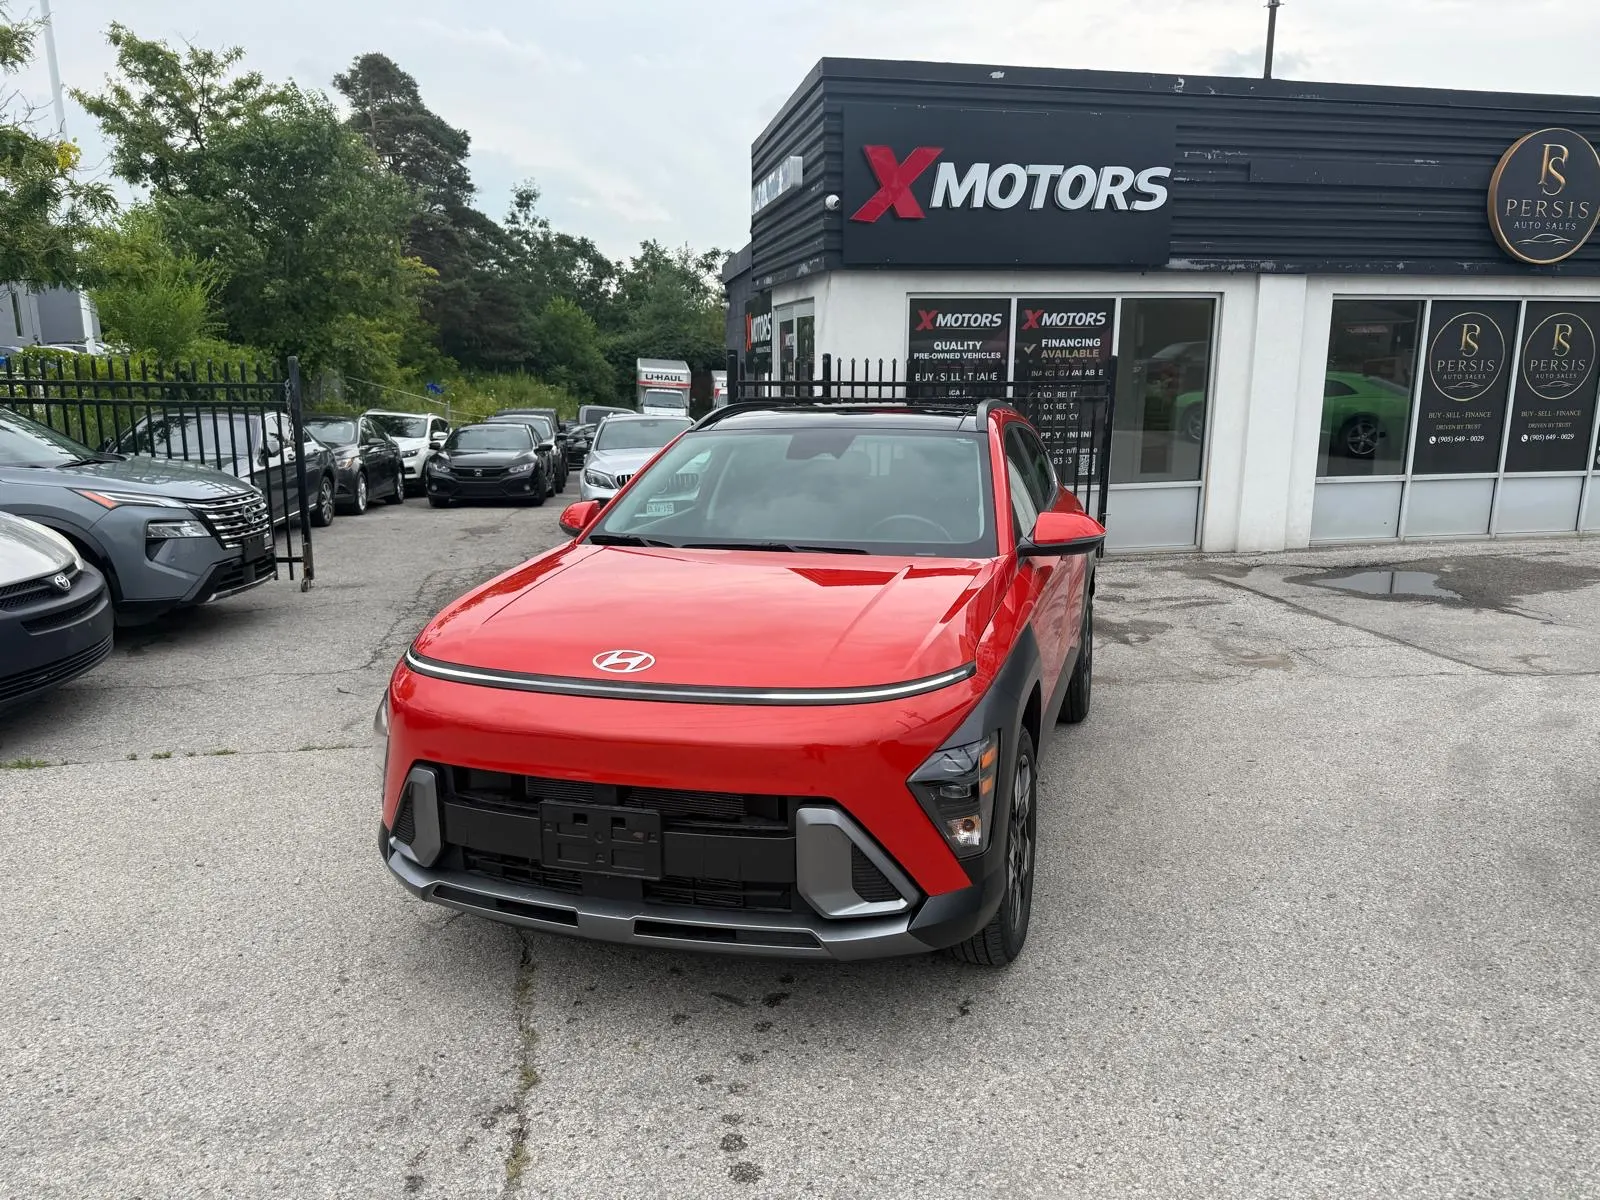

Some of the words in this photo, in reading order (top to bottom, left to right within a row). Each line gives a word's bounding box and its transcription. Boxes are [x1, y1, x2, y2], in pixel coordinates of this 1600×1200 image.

[930, 162, 1171, 210] MOTORS
[1504, 199, 1590, 219] PERSIS
[1514, 221, 1541, 230] AUTO
[1545, 222, 1577, 231] SALES
[936, 313, 1002, 327] MOTORS
[1041, 312, 1106, 326] MOTORS
[751, 312, 772, 343] MOTORS
[933, 341, 982, 351] QUALITY
[1041, 338, 1101, 348] FINANCING
[914, 352, 960, 360] PRE-OWNED
[962, 352, 1001, 360] VEHICLES
[1041, 349, 1099, 358] AVAILABLE
[1437, 359, 1495, 371] PERSIS
[1530, 359, 1585, 371] PERSIS
[645, 373, 683, 382] U-HAUL
[1428, 411, 1442, 419] BUY
[1446, 411, 1460, 419] SELL
[1438, 435, 1454, 444] (905)
[1530, 434, 1545, 442] (905)
[1560, 433, 1575, 441] 0029
